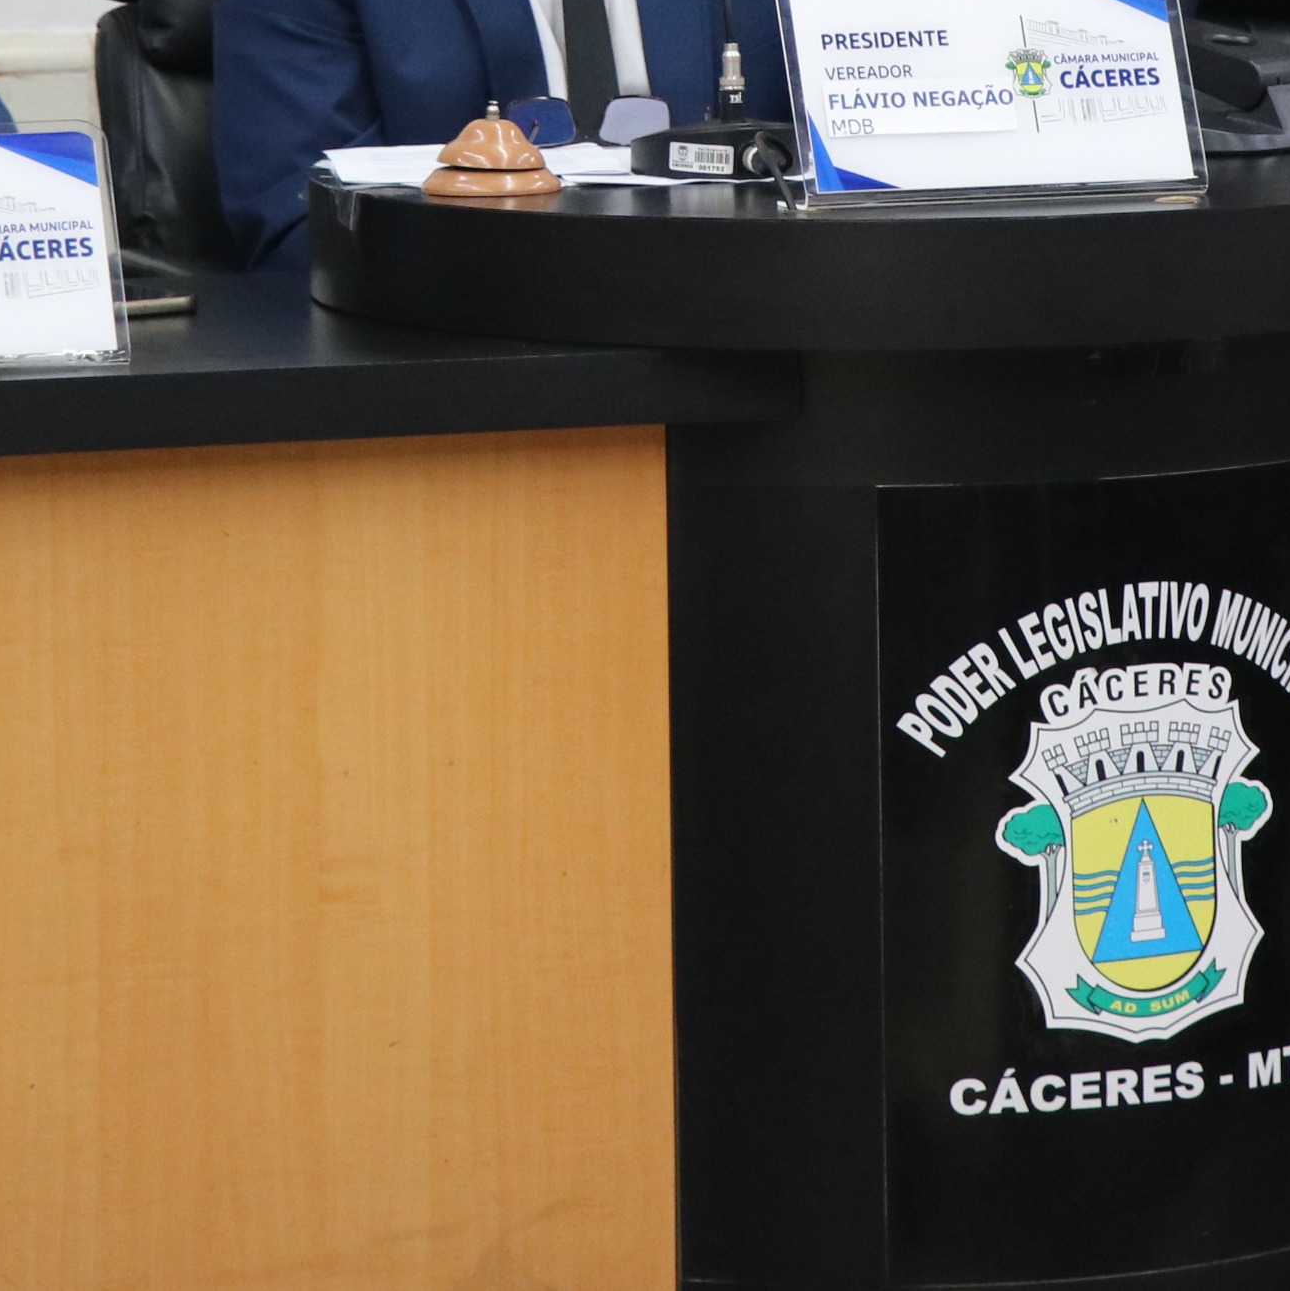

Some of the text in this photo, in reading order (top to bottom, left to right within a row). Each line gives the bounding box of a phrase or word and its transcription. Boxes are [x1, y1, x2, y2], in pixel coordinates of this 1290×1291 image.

[821, 29, 950, 51] PRESIDENTE
[1054, 51, 1160, 65] CÂMARA MUNICIPAL
[825, 64, 913, 81] VEREADOR
[1060, 65, 1161, 89] CÁCERES
[828, 84, 1014, 110] FLÁVIO NEGAÇÃO
[831, 118, 875, 136] MDB
[29, 219, 94, 233] MUNICIPAL
[896, 642, 1016, 758] PODER
[998, 581, 1210, 680] LEGISLATIVO
[1049, 669, 1225, 716] CÁCERES
[1110, 990, 1190, 1013] AD SUM
[949, 1061, 1205, 1116] CÁCERES
